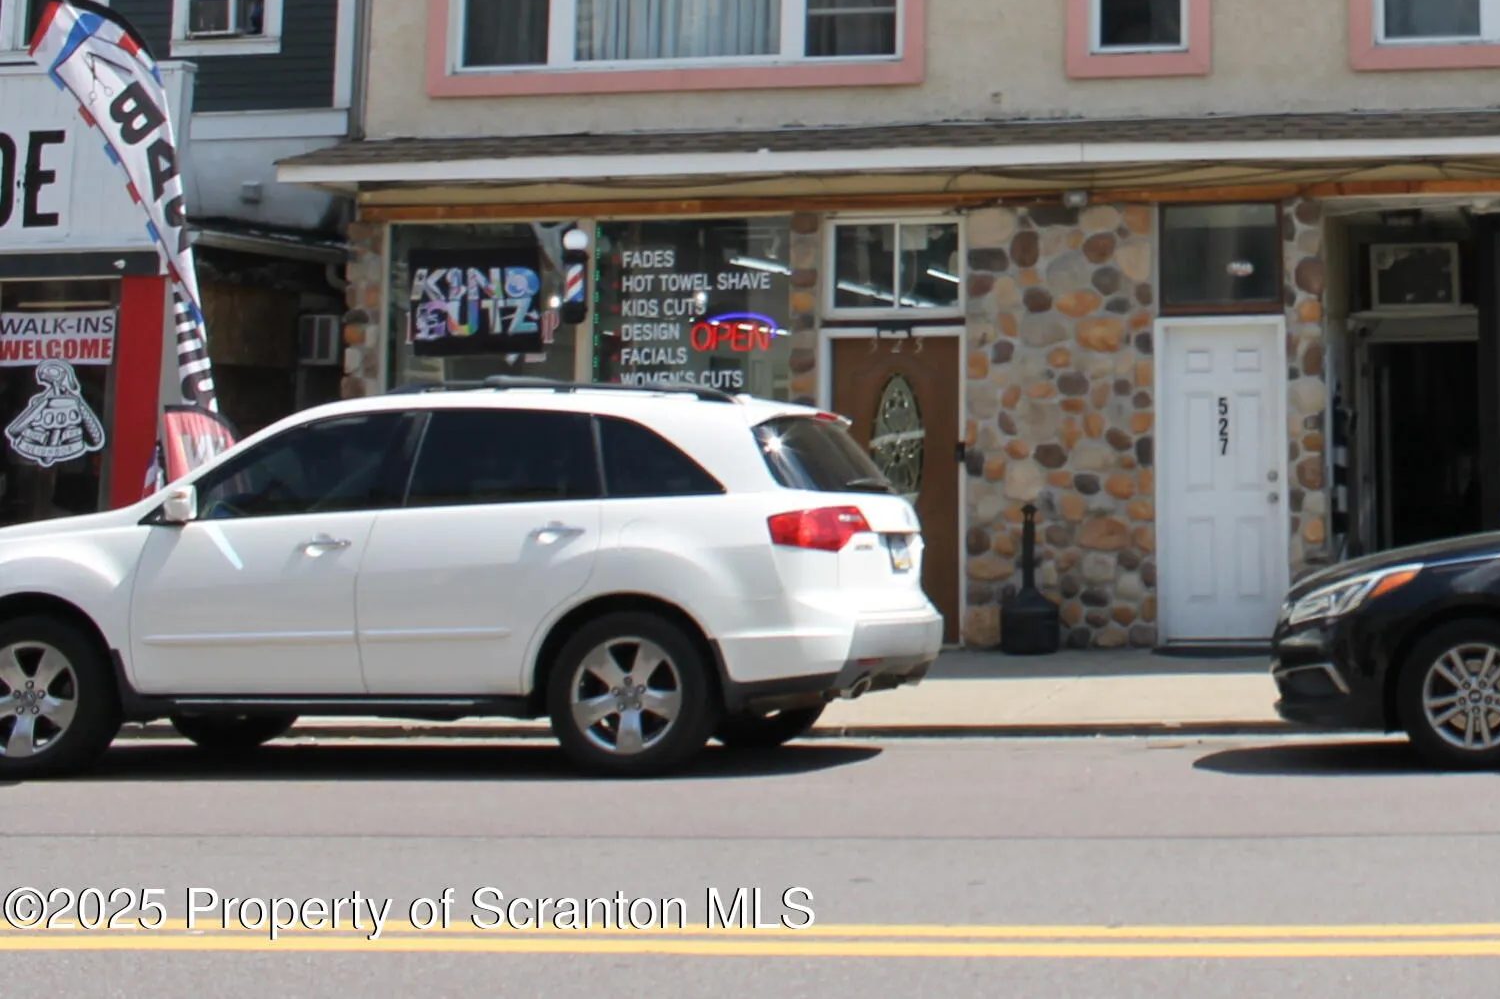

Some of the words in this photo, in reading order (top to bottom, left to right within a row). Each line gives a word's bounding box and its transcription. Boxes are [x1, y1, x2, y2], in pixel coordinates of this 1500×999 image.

[622, 250, 675, 268] FADES
[621, 275, 655, 293] HOT
[659, 274, 712, 292] TOWEL
[717, 272, 771, 290] SHAVE
[621, 299, 659, 317] KIDS
[663, 298, 706, 316] CUTS
[0, 316, 113, 335] WALK-INS
[621, 324, 680, 341] DESIGN
[690, 321, 771, 351] OPEN
[0, 339, 112, 361] WELCOME
[620, 348, 687, 365] FACIALS
[620, 371, 695, 386] WOMEN'S
[700, 370, 743, 388] CUTS
[1218, 397, 1228, 455] 527
